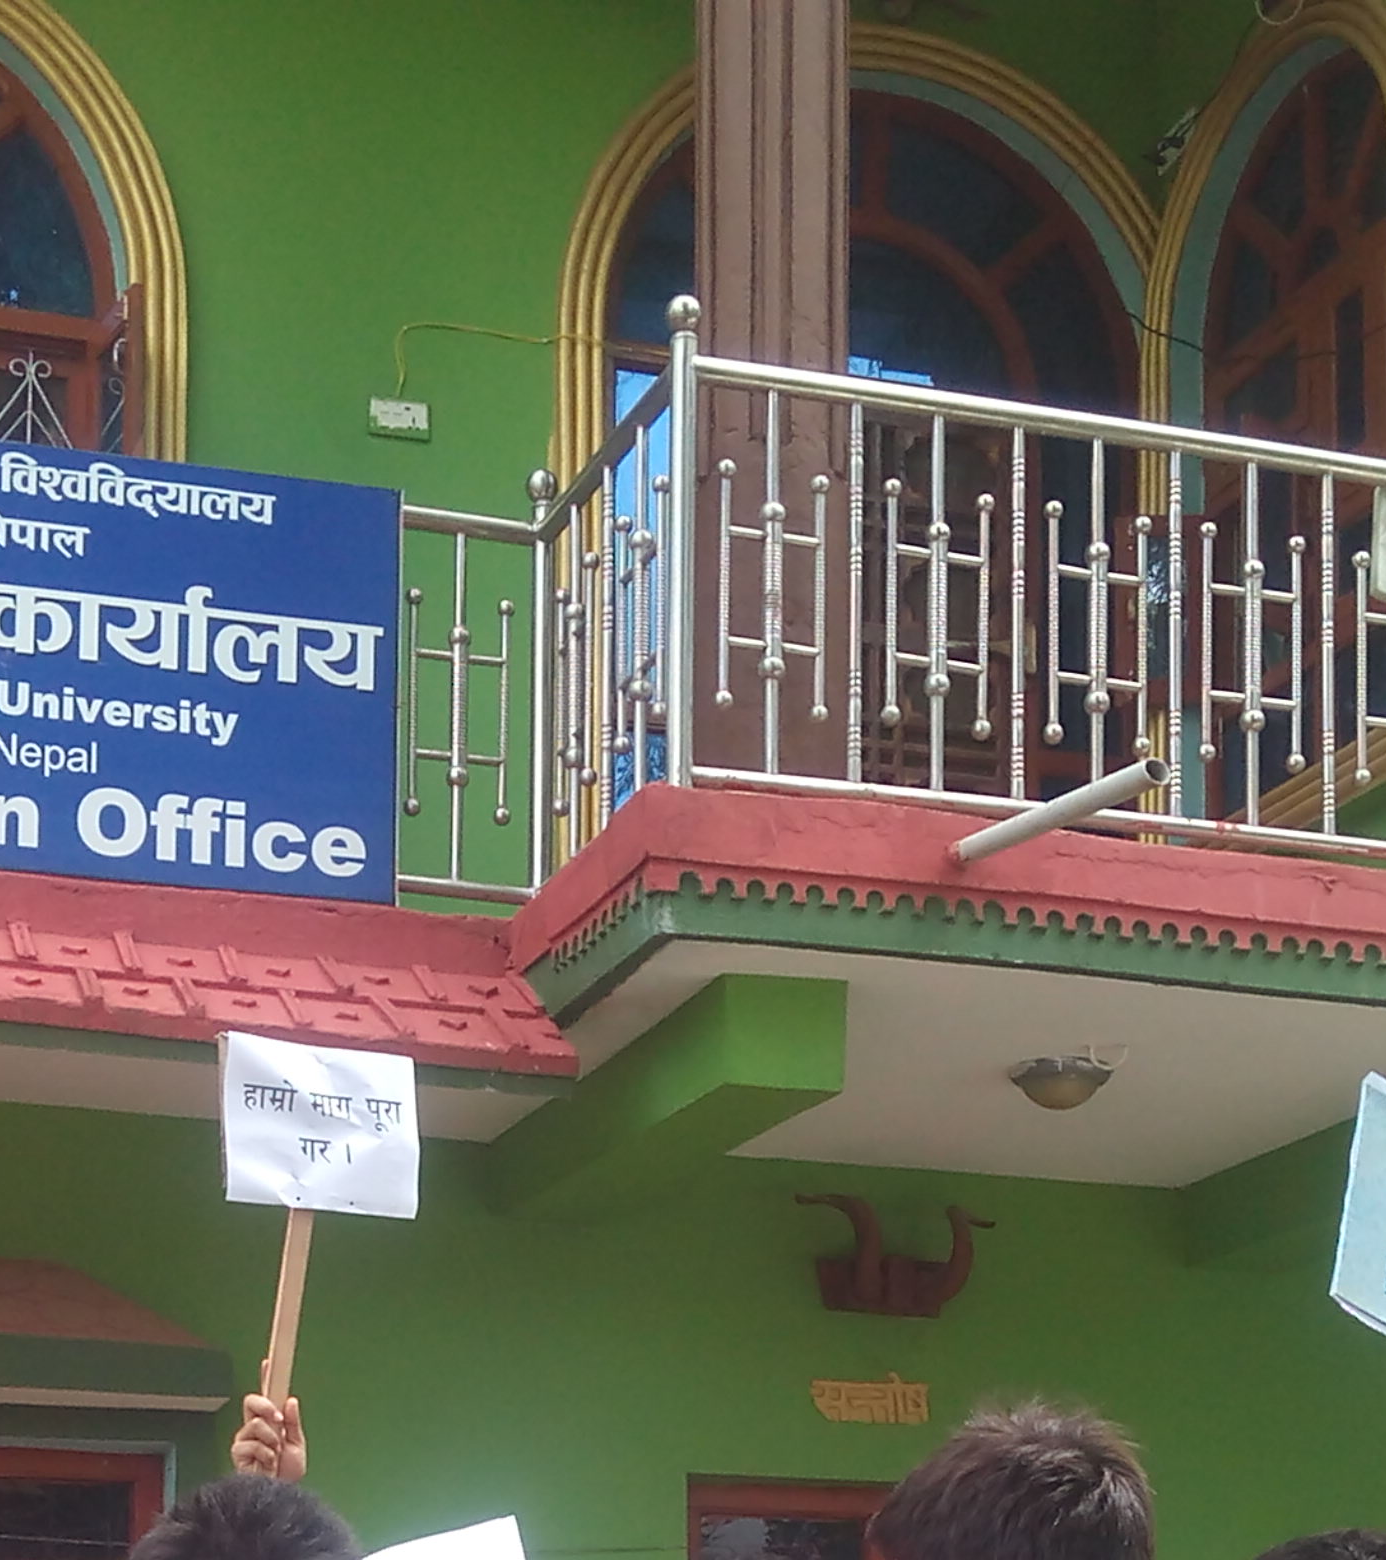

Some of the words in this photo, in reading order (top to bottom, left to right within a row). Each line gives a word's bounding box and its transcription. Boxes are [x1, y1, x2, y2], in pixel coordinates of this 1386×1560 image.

[77, 786, 367, 877] Office
[243, 1080, 298, 1112] हाम्रो
[309, 1092, 352, 1120] माग
[365, 1098, 402, 1132] पूरा
[299, 1137, 331, 1163] गर
